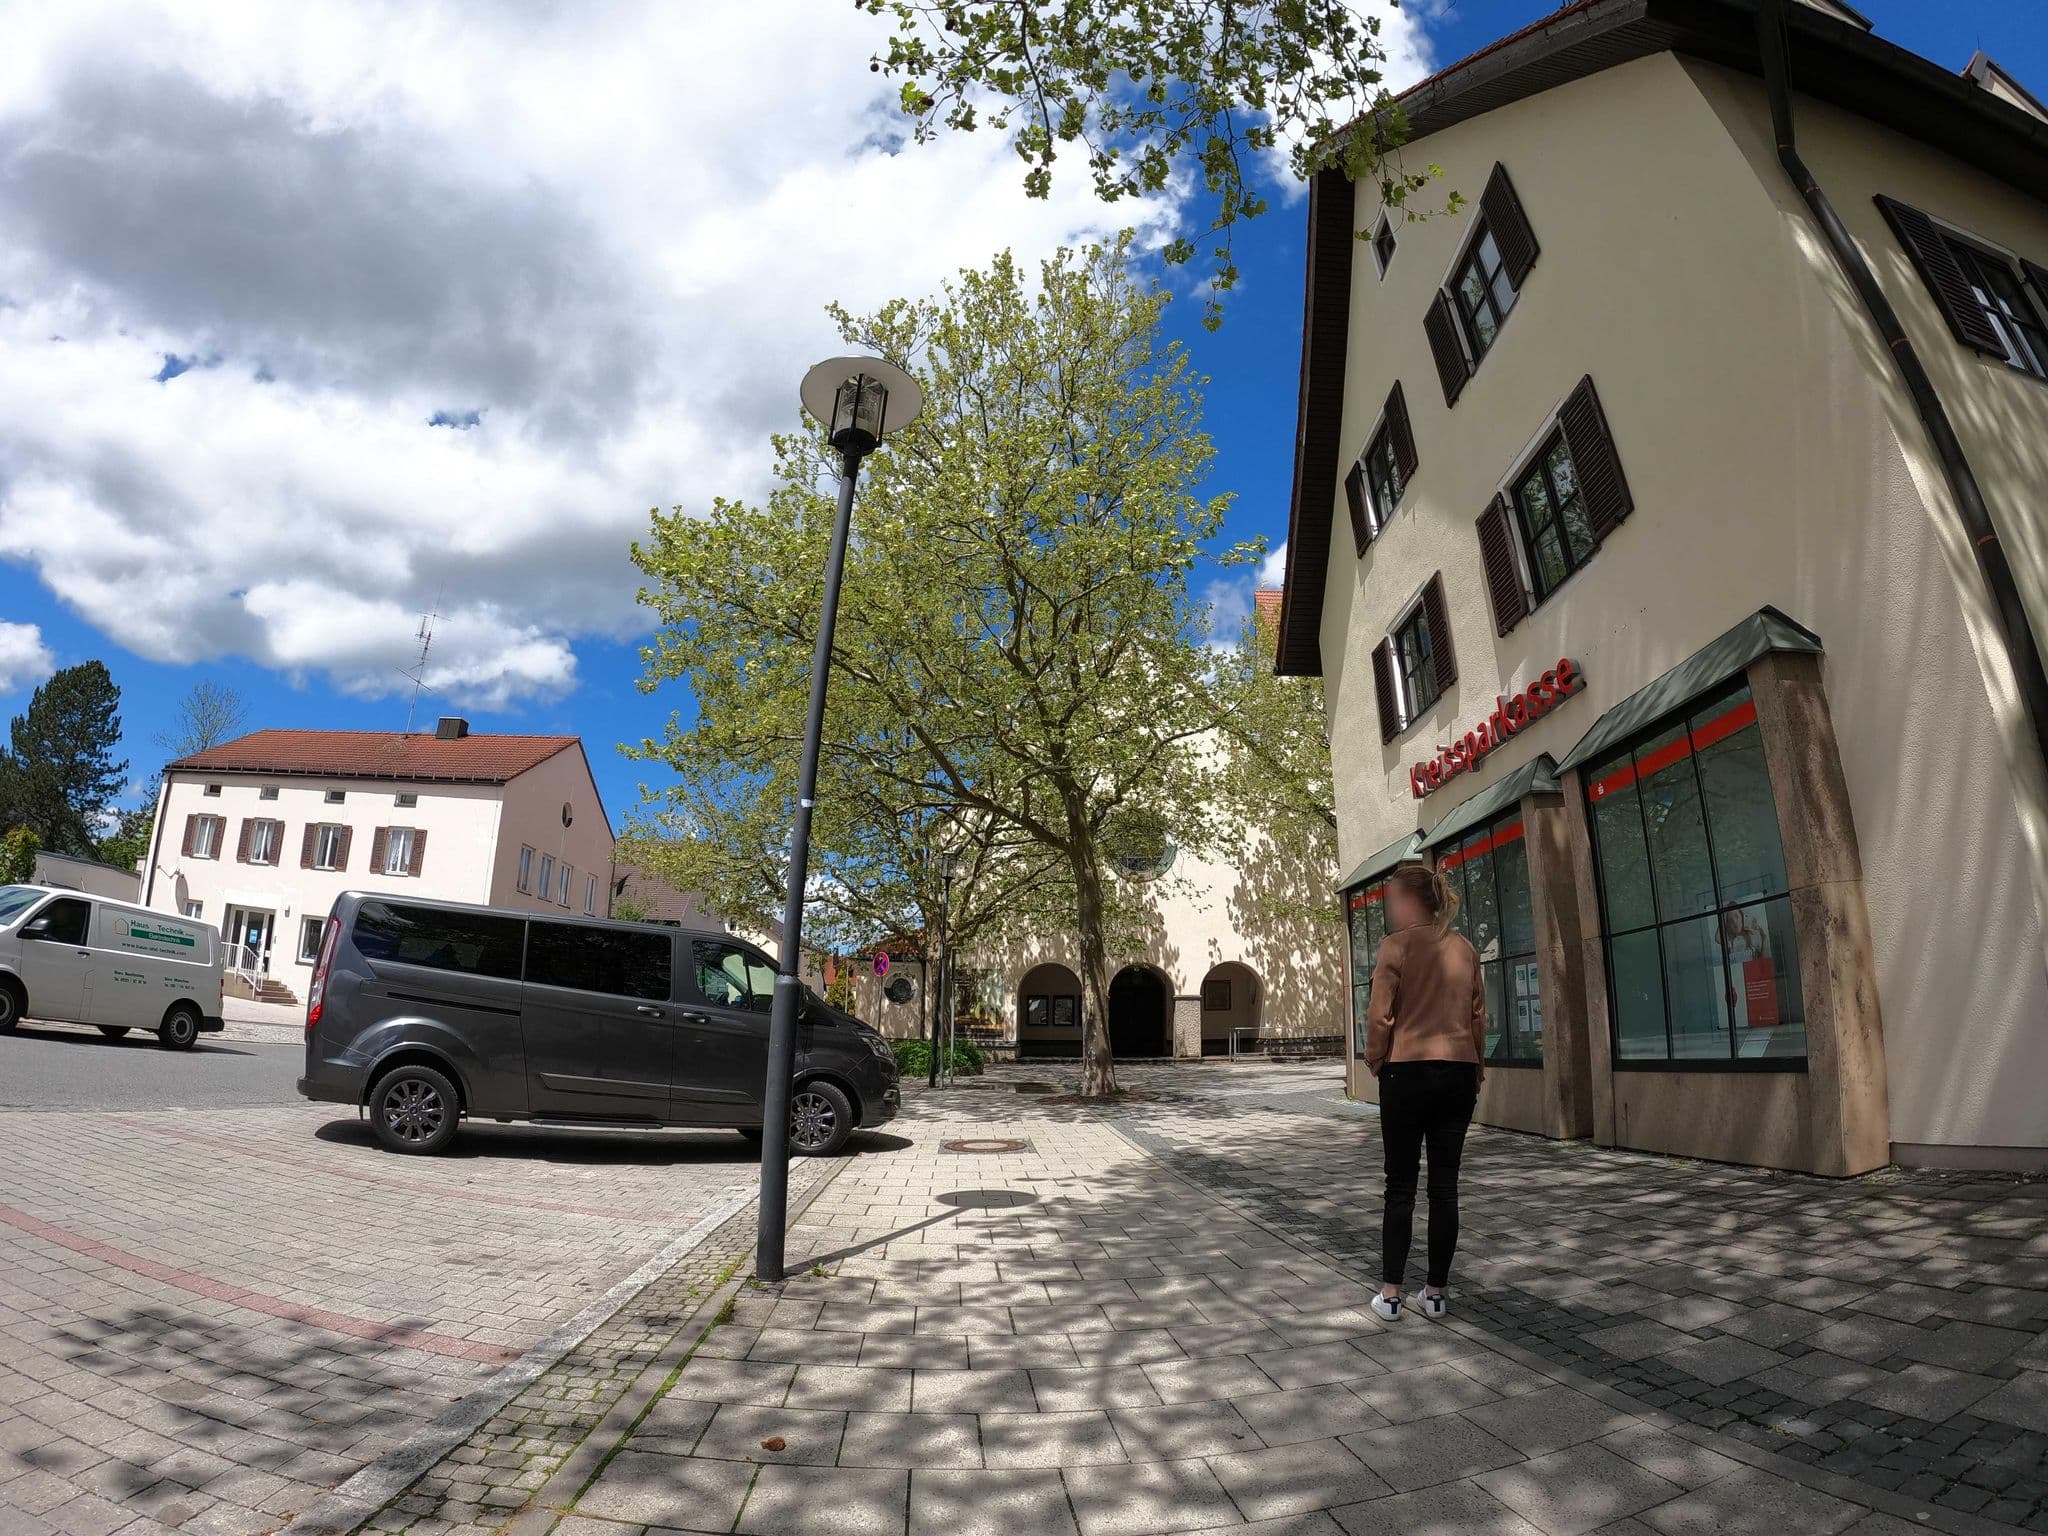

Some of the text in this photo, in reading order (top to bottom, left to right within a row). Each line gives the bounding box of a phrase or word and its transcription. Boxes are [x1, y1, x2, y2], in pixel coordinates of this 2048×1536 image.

[1409, 658, 1580, 800] Kreissparkasse
[130, 919, 149, 929] Haus
[157, 924, 183, 935] Technik
